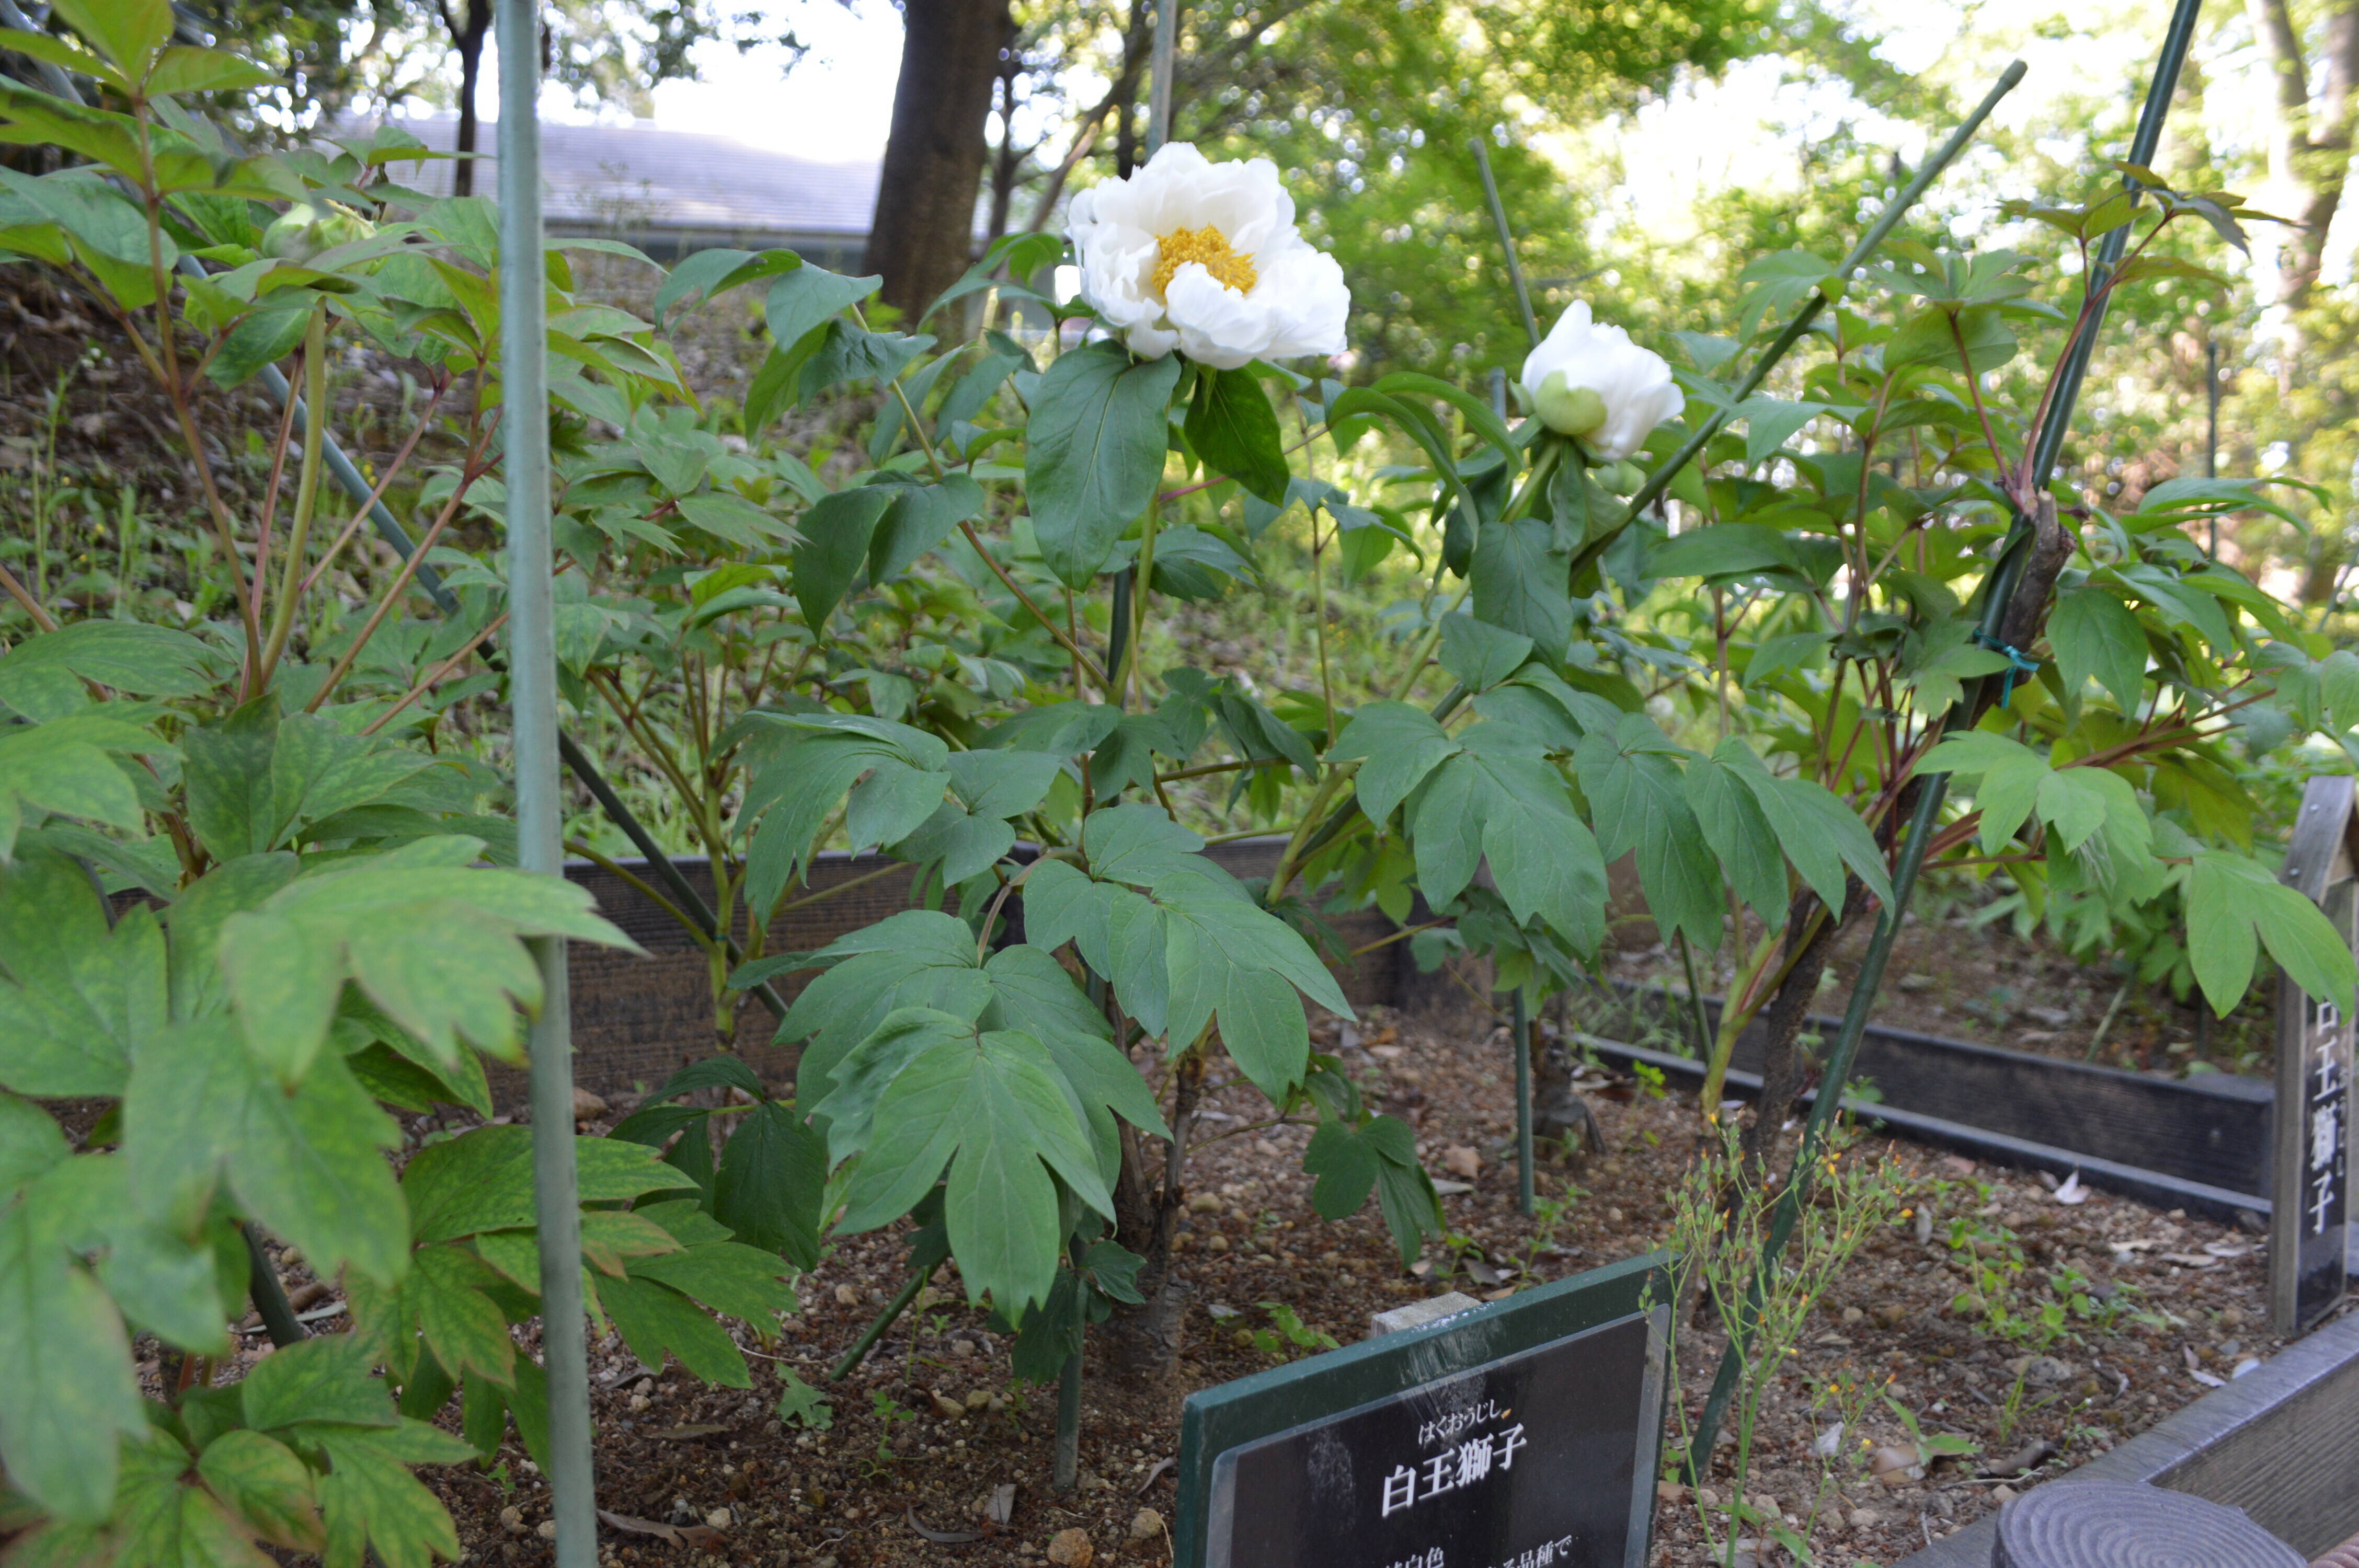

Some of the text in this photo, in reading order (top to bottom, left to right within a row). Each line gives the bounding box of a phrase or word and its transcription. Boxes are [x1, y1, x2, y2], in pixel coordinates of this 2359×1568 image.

[1418, 1399, 1502, 1445] はくおうじし
[1382, 1423, 1527, 1517] 白王獅子
